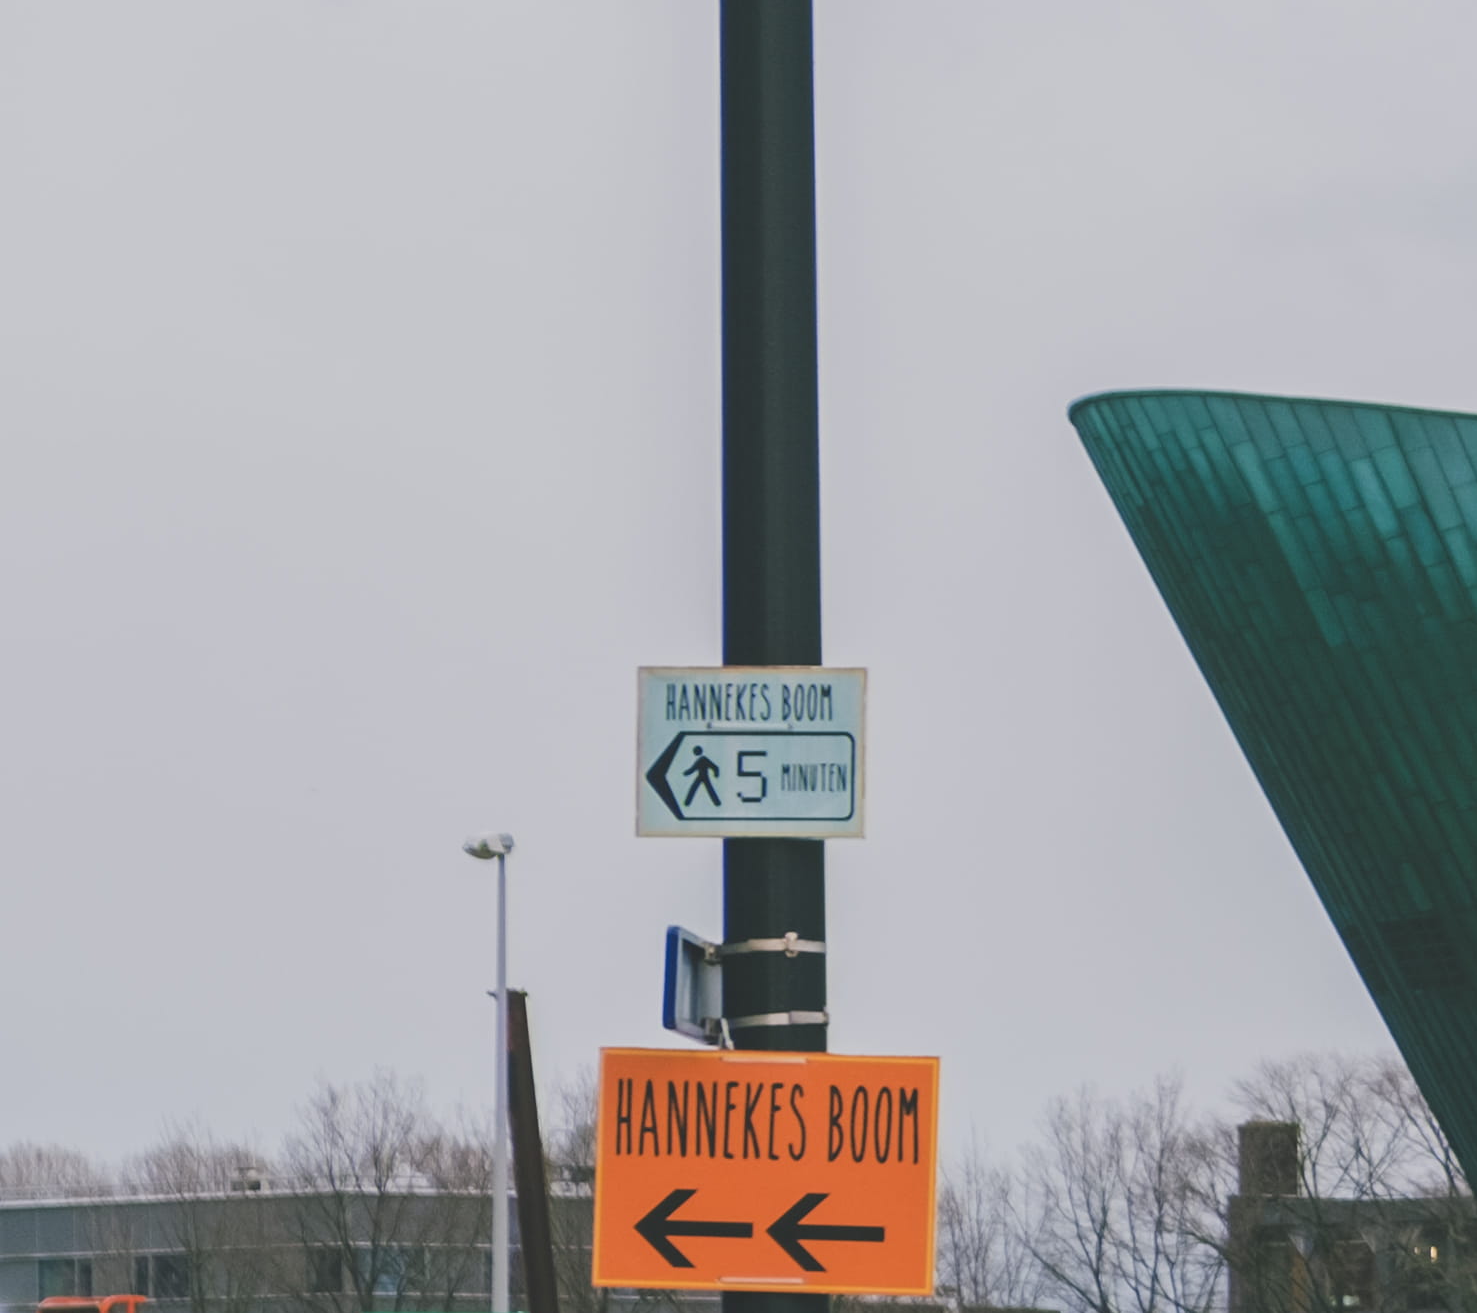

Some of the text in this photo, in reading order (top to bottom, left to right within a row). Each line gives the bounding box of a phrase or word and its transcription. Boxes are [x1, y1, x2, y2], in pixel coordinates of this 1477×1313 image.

[666, 684, 833, 721] HANNEKES BOOM
[737, 751, 847, 803] 5 MINUTEN
[615, 1078, 919, 1165] HANNEKES BOOM
